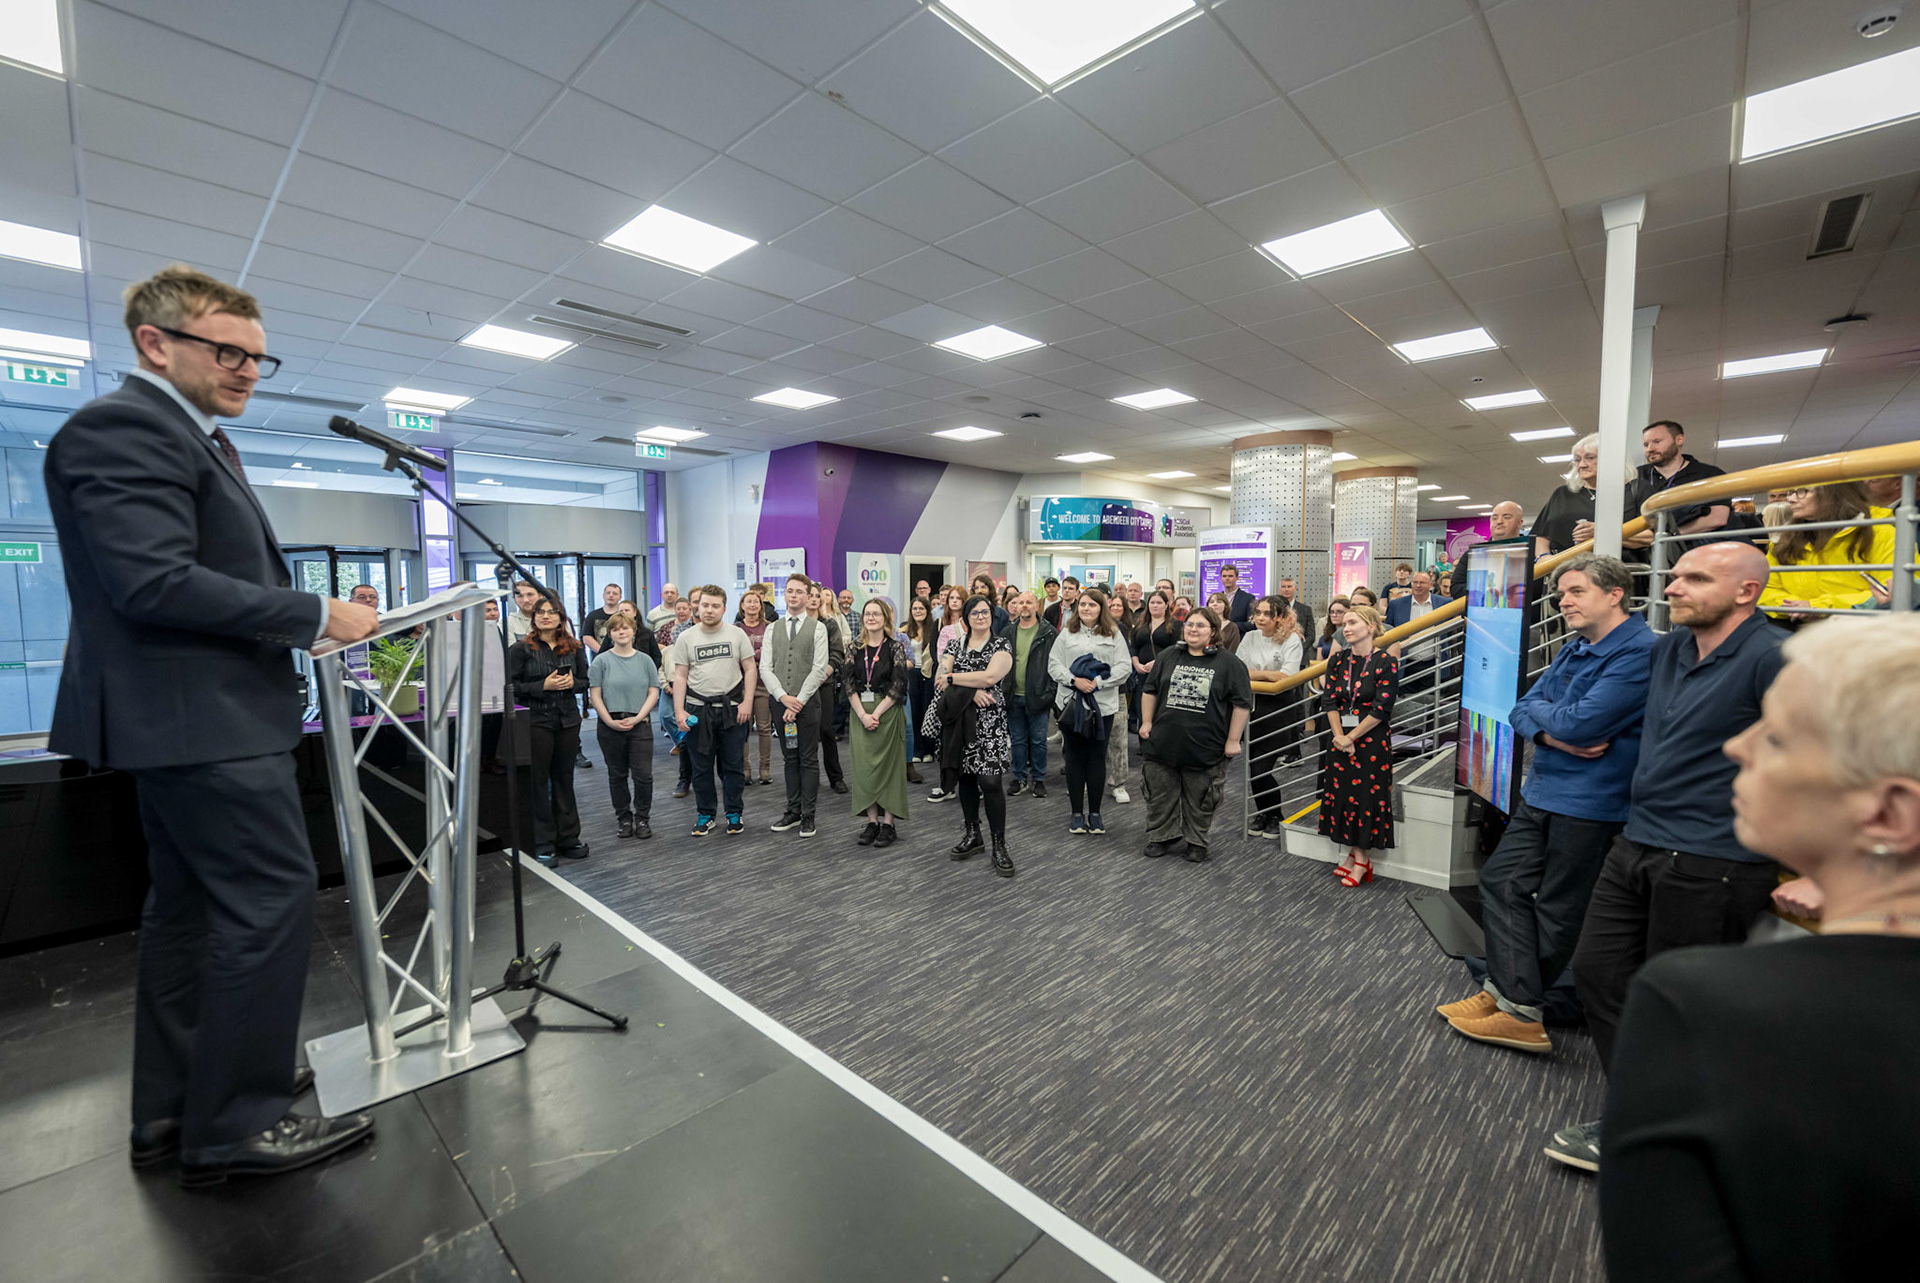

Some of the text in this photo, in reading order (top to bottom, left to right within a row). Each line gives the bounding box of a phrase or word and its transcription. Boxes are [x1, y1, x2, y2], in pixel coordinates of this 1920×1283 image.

[1058, 514, 1090, 524] WELCOME
[1093, 514, 1101, 524] TO
[1102, 514, 1130, 526] ABERDEEN
[1130, 516, 1140, 527] CITY
[699, 646, 729, 657] oasis
[1175, 665, 1215, 675] RADIOHEAD
